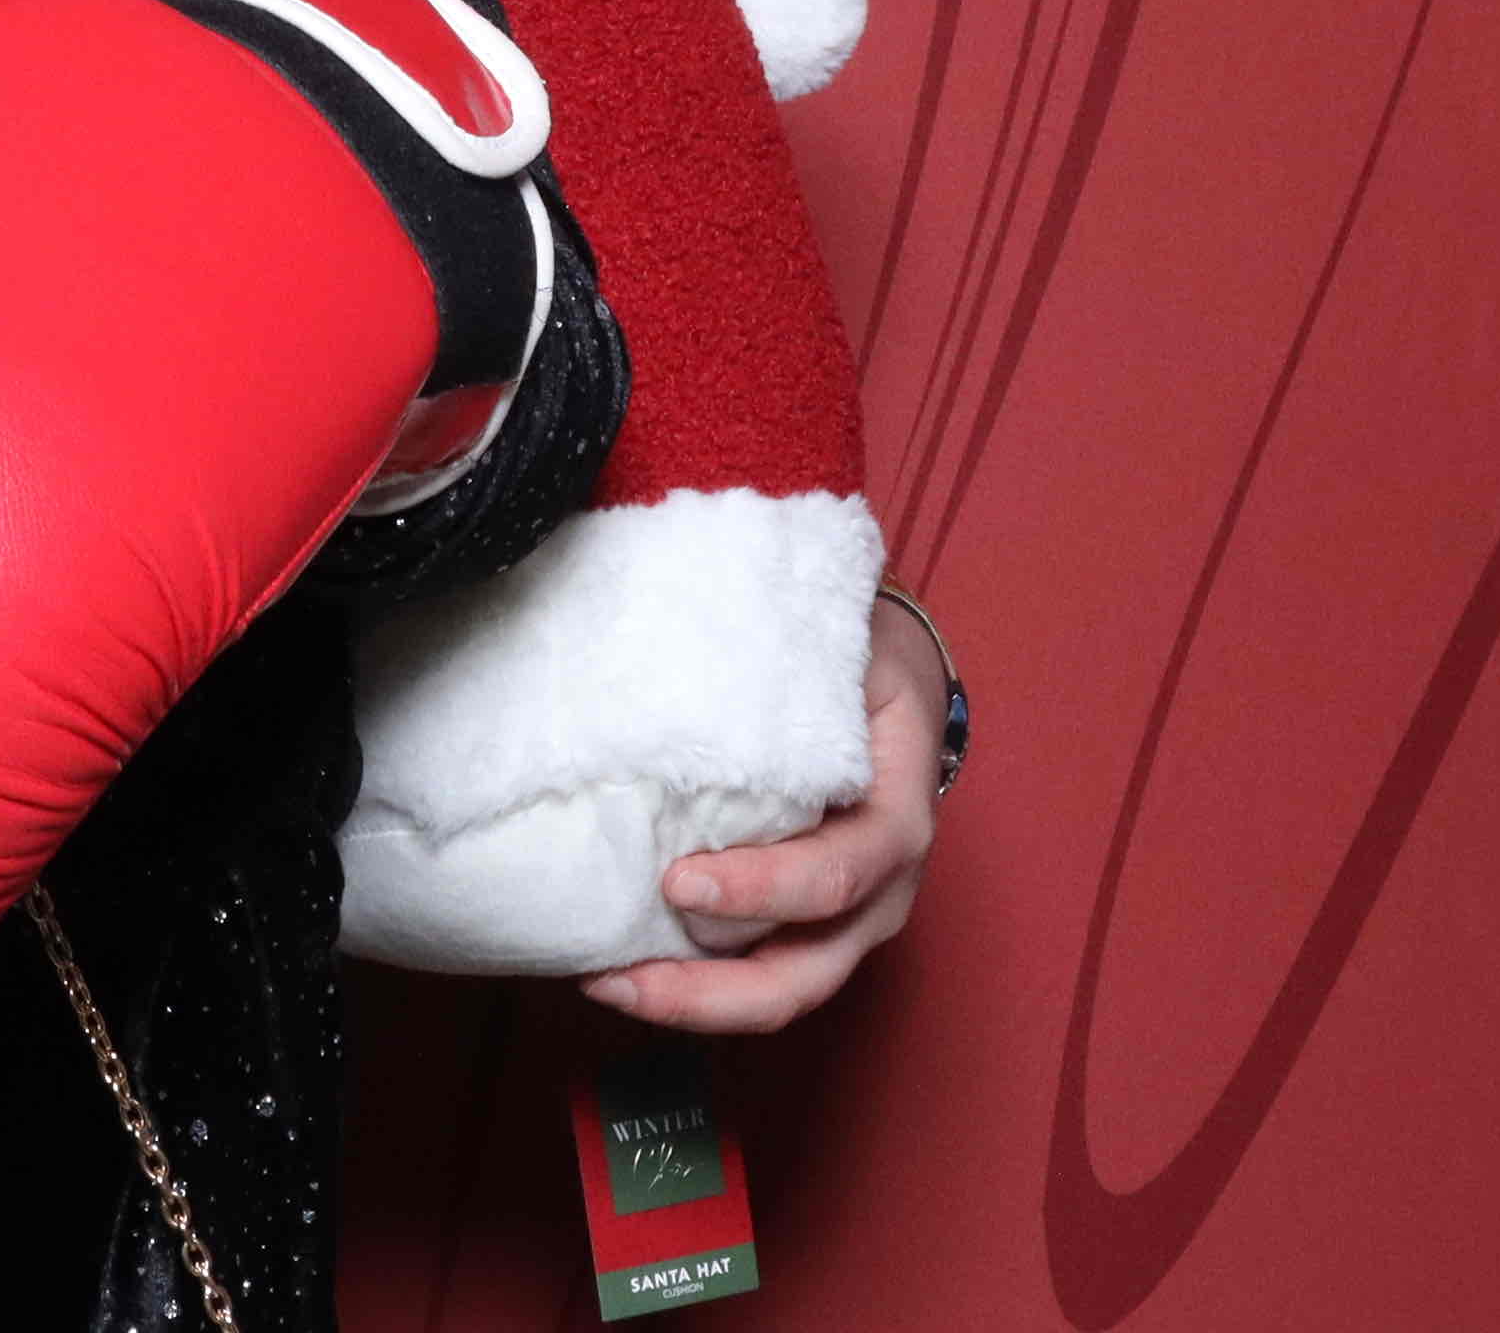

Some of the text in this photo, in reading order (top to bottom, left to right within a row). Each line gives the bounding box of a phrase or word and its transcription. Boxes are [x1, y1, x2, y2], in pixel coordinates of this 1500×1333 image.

[612, 1109, 704, 1142] WINTER
[630, 1257, 731, 1293] SANTA HAT
[662, 1282, 704, 1299] CUSHION
